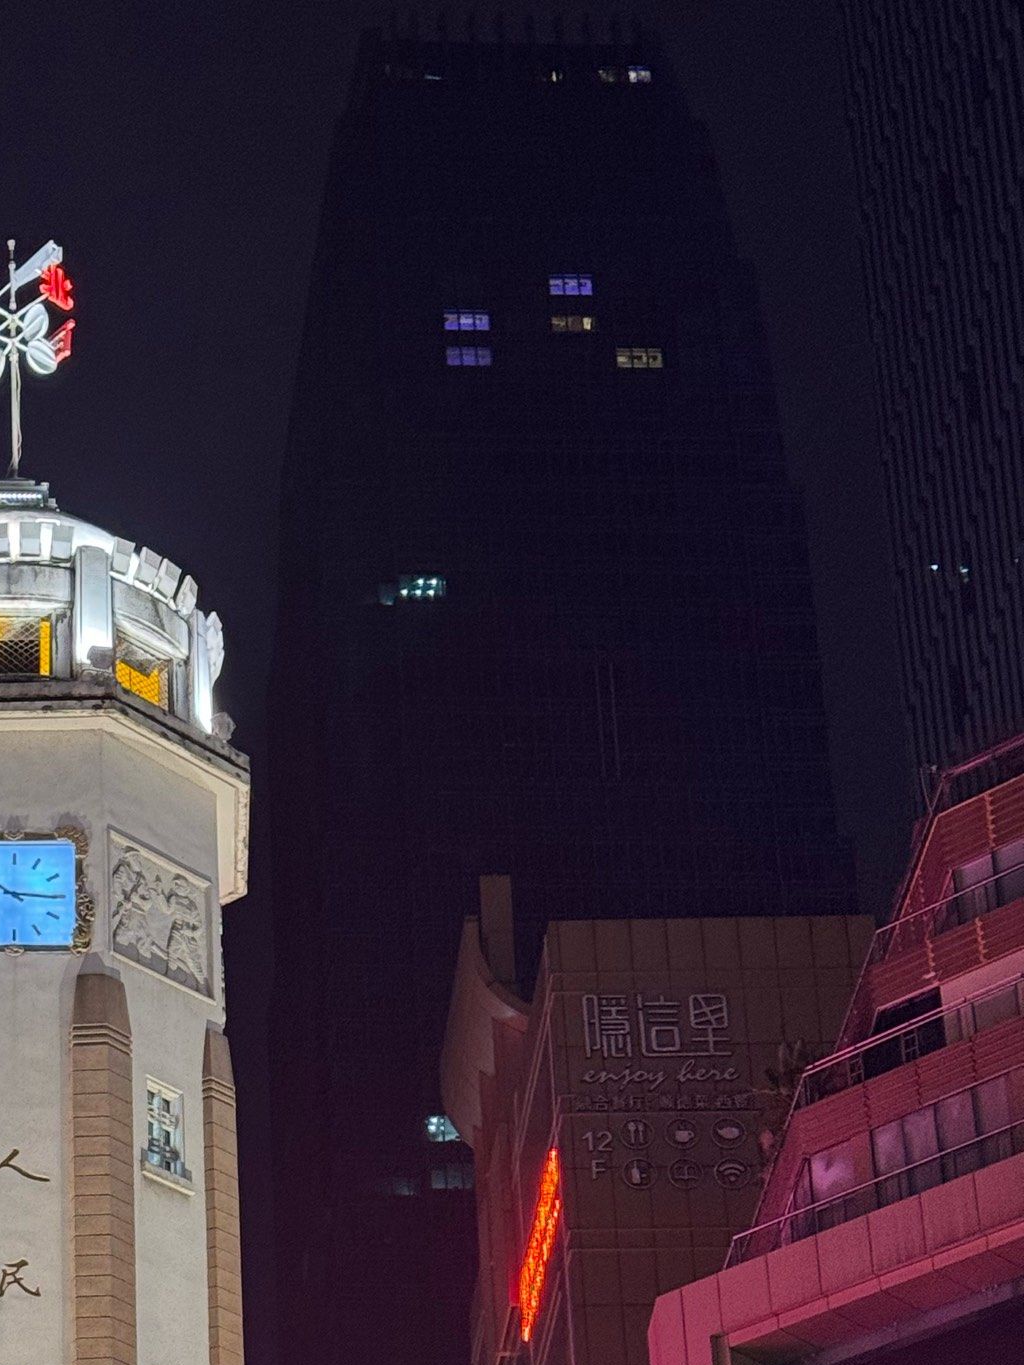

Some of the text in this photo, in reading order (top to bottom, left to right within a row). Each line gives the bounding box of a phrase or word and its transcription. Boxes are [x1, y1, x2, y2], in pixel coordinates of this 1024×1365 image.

[583, 1059, 740, 1091] enjoy here
[582, 1130, 613, 1151] 12
[592, 1159, 606, 1180] F
